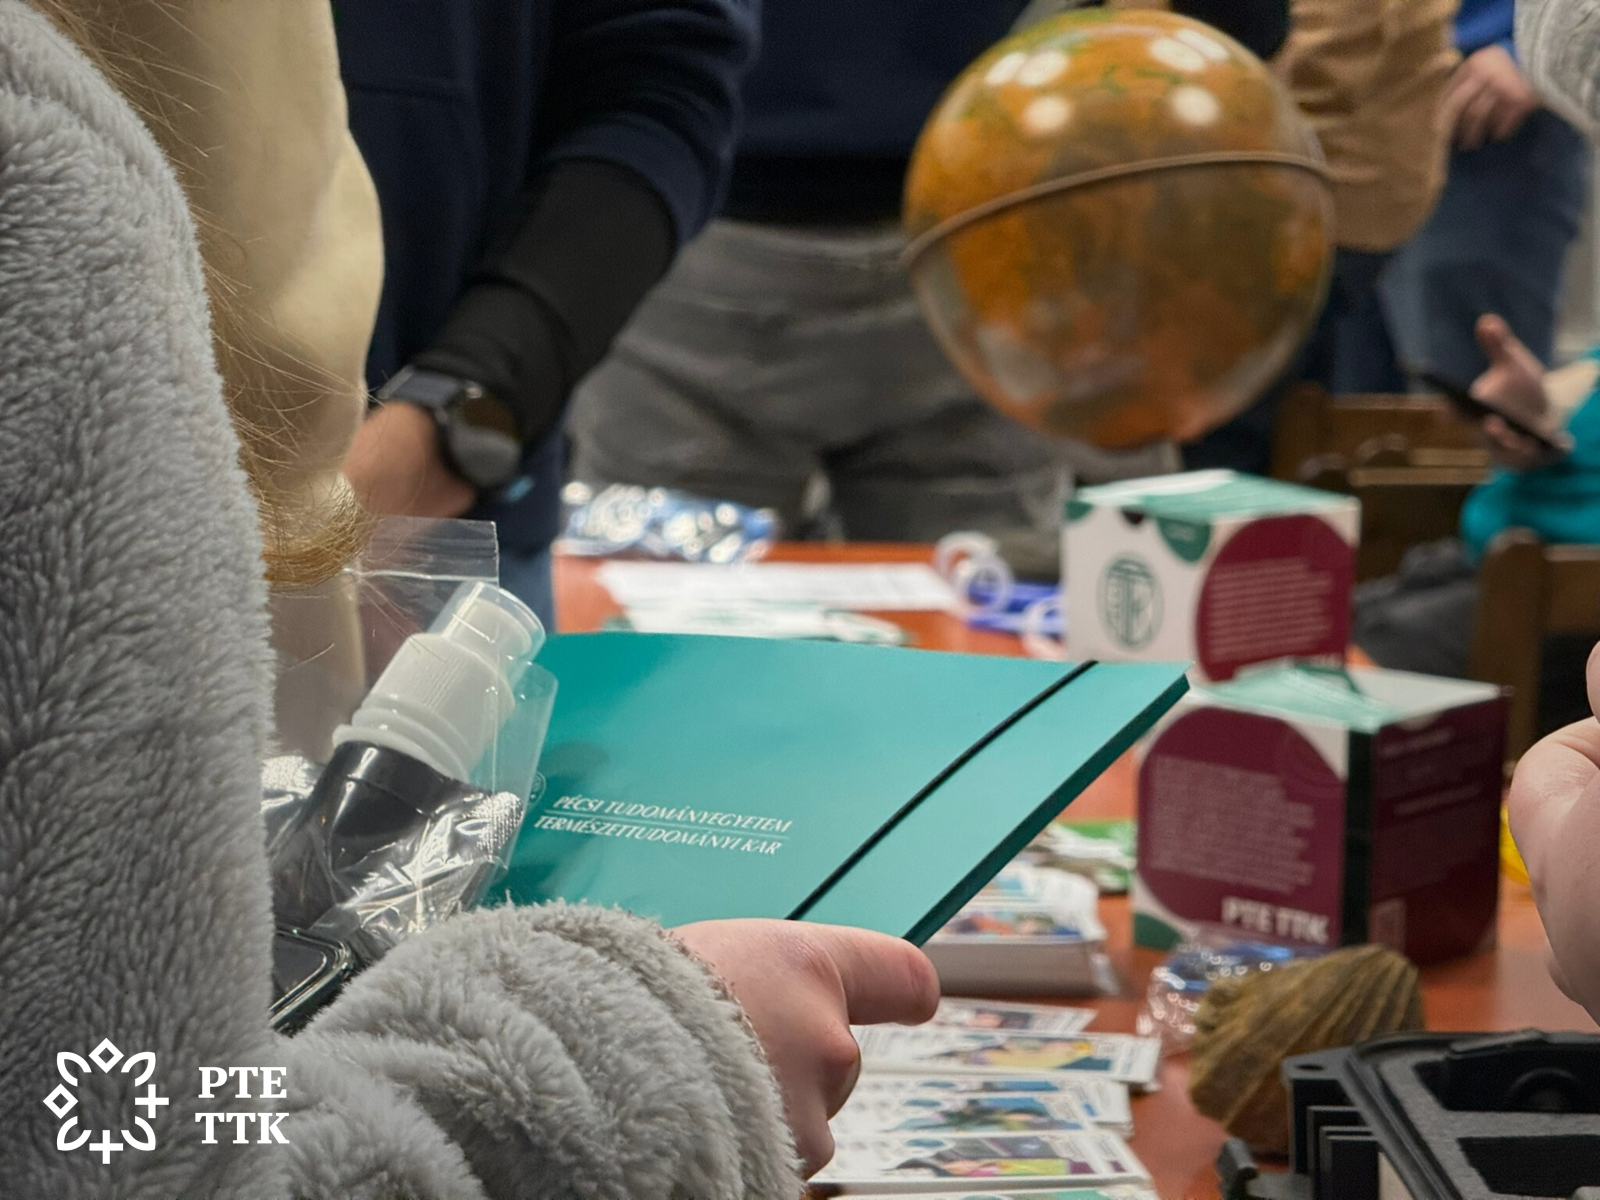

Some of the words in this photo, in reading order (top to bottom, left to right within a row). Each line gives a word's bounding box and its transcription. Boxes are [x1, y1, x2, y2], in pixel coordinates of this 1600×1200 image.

[553, 794, 605, 812] PÉCSI
[604, 801, 793, 833] TUDOMÁNYEGYETEM
[534, 815, 742, 850] TERMÉSZETTUDOMÁNYI
[739, 839, 782, 855] KAR
